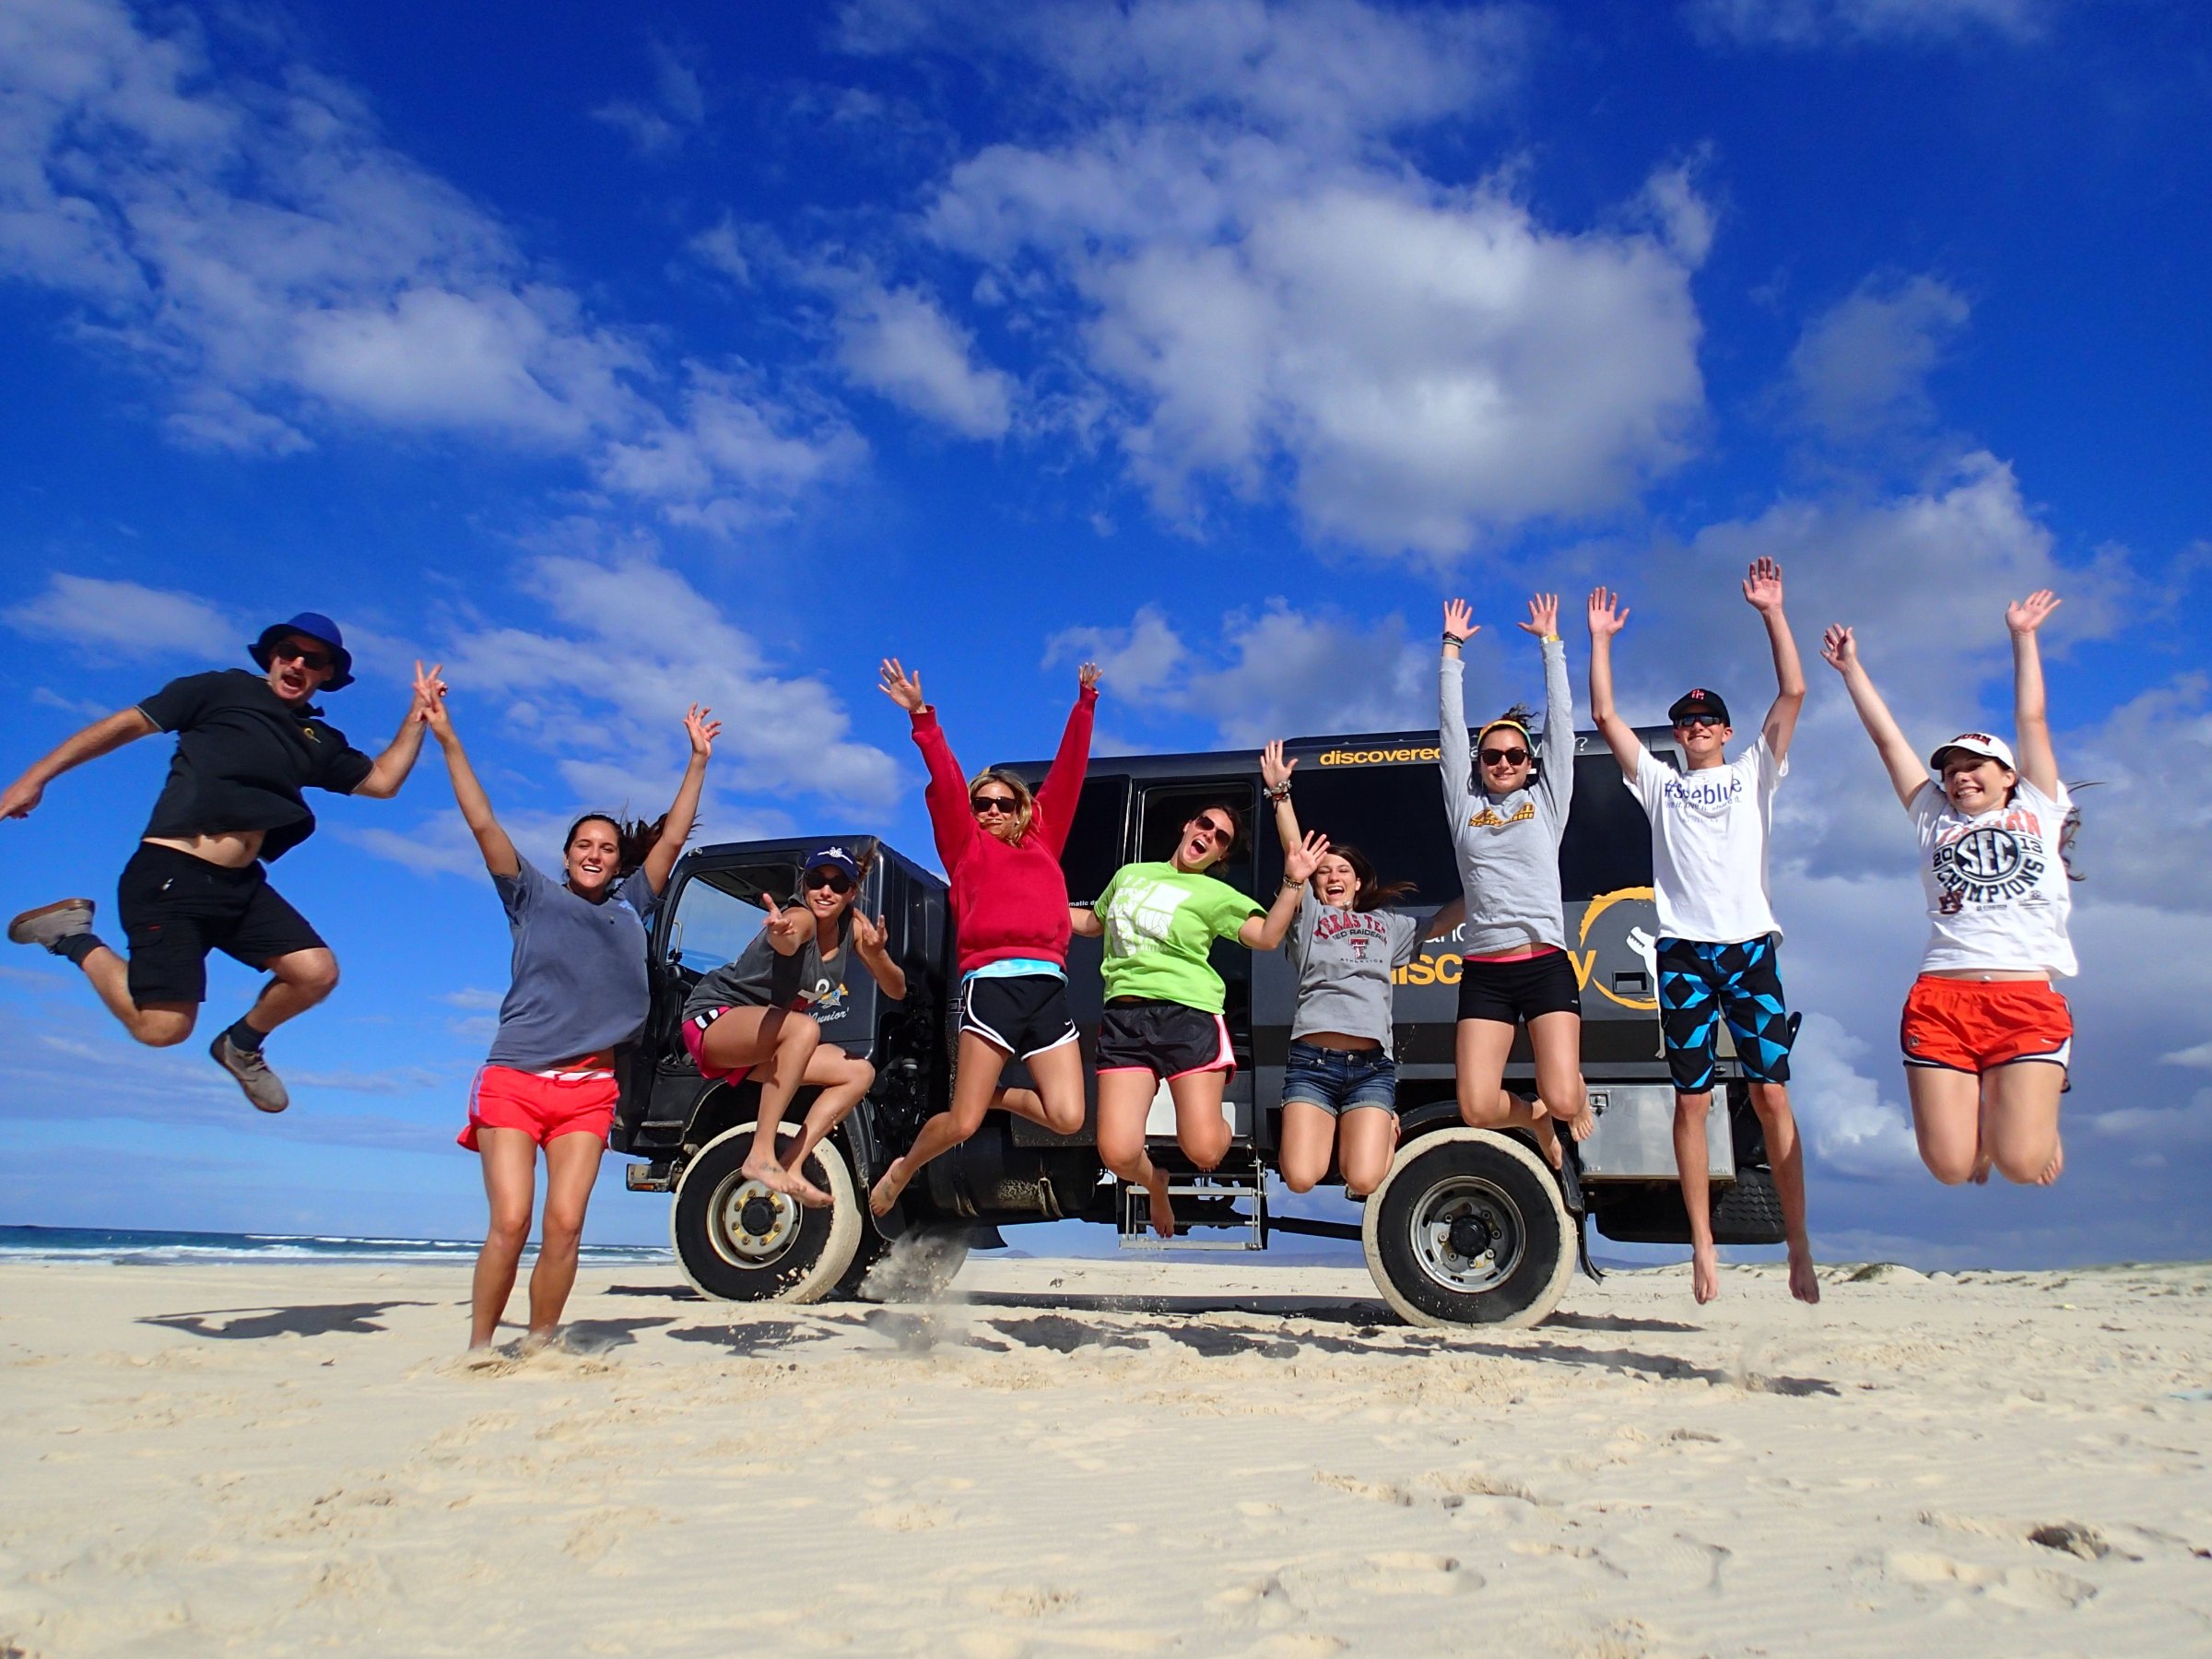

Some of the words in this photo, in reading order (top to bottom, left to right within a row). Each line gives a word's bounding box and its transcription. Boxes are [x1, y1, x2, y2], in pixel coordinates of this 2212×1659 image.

[1934, 847, 1954, 867] 20
[1956, 830, 2017, 876] SEC
[2019, 837, 2043, 854] 13
[1936, 857, 2045, 903] CHAMPIONS
[1313, 912, 1361, 940] TEXAS
[1349, 928, 1386, 941] RAIDER
